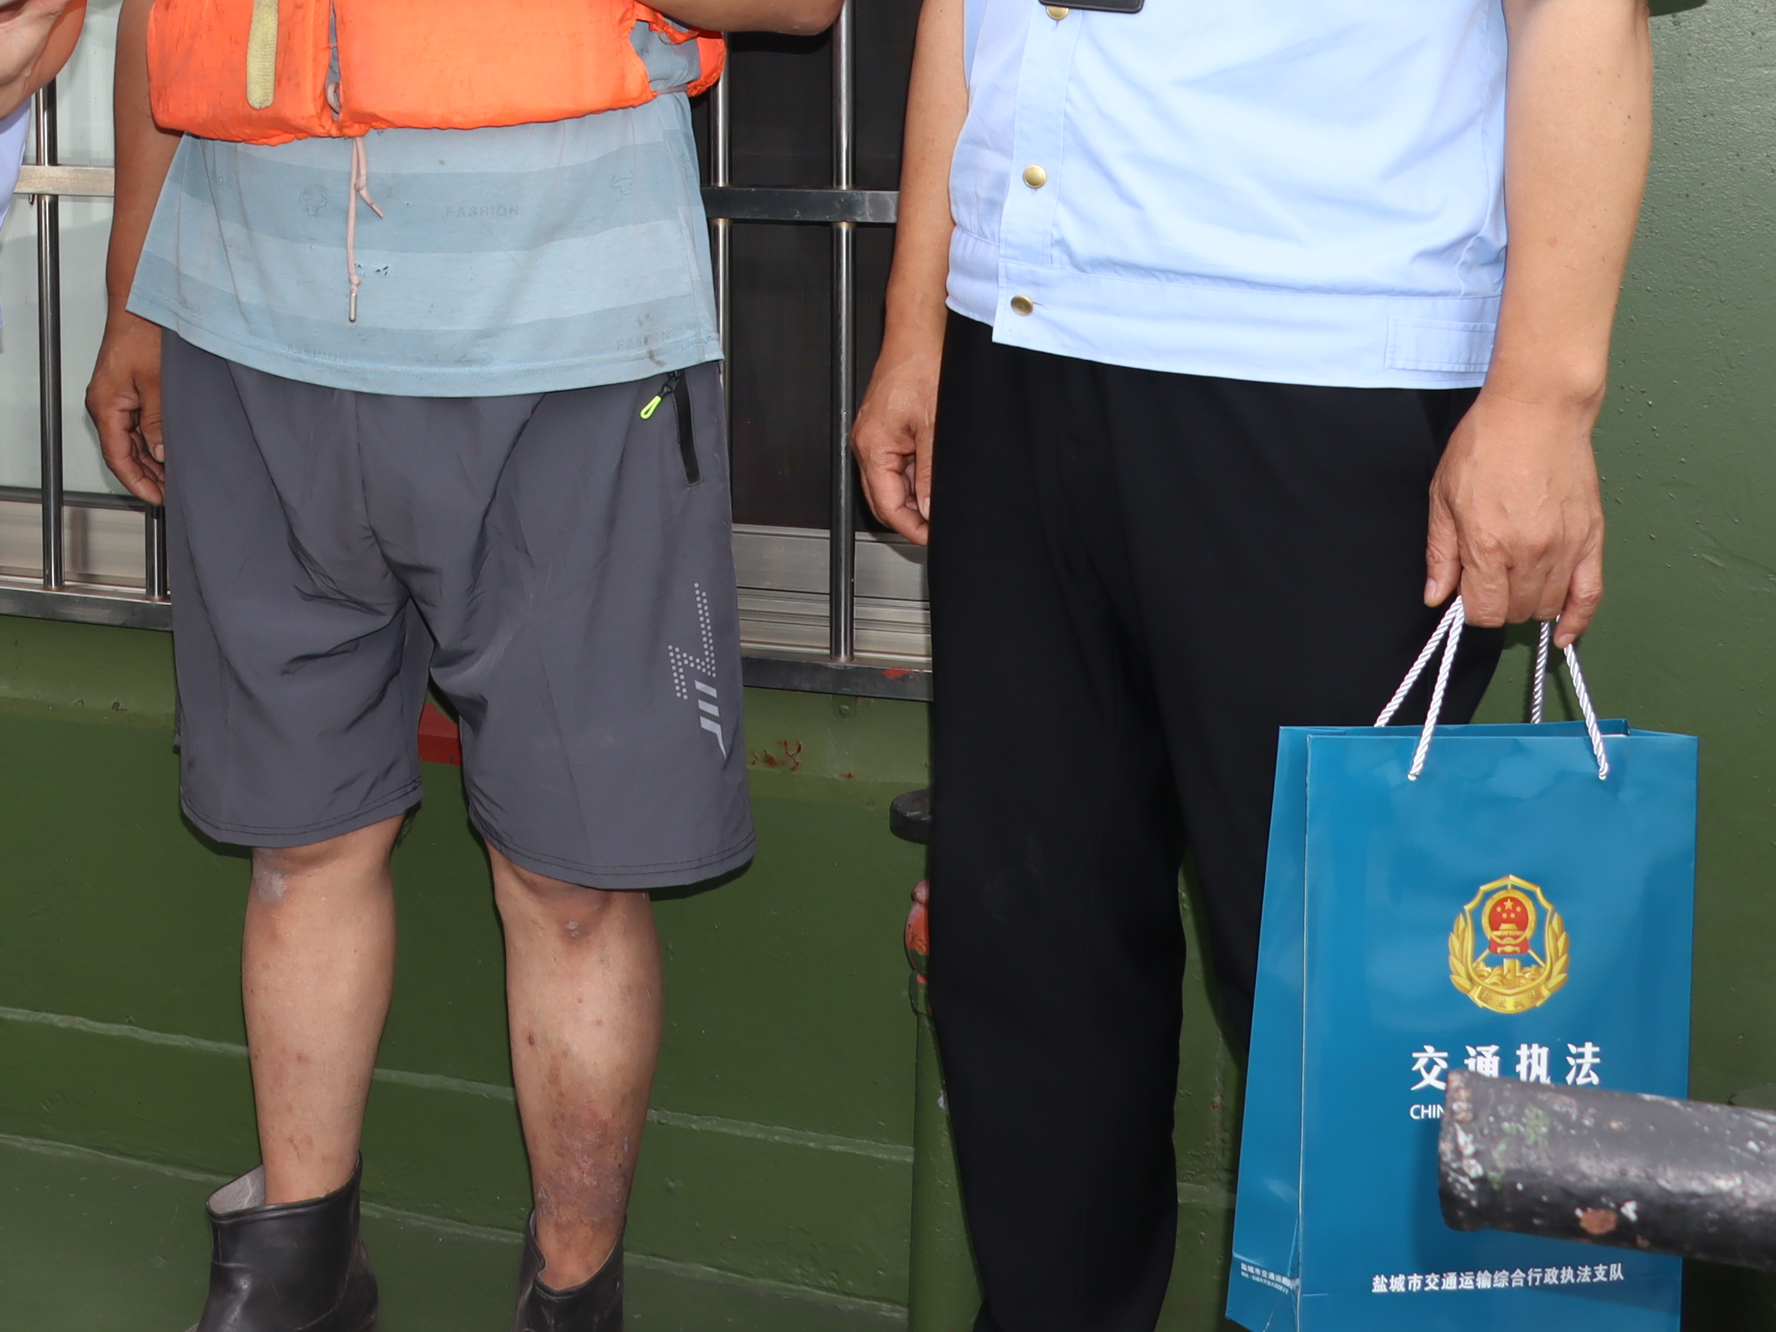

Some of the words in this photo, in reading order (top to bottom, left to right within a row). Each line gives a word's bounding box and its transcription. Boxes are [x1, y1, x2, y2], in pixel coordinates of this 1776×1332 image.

[445, 204, 519, 219] FASHION
[1410, 1041, 1601, 1091] 交通执法
[1409, 1104, 1445, 1120] CHIN
[1371, 1262, 1625, 1294] 盐城市交通运输综合行政执法支队
